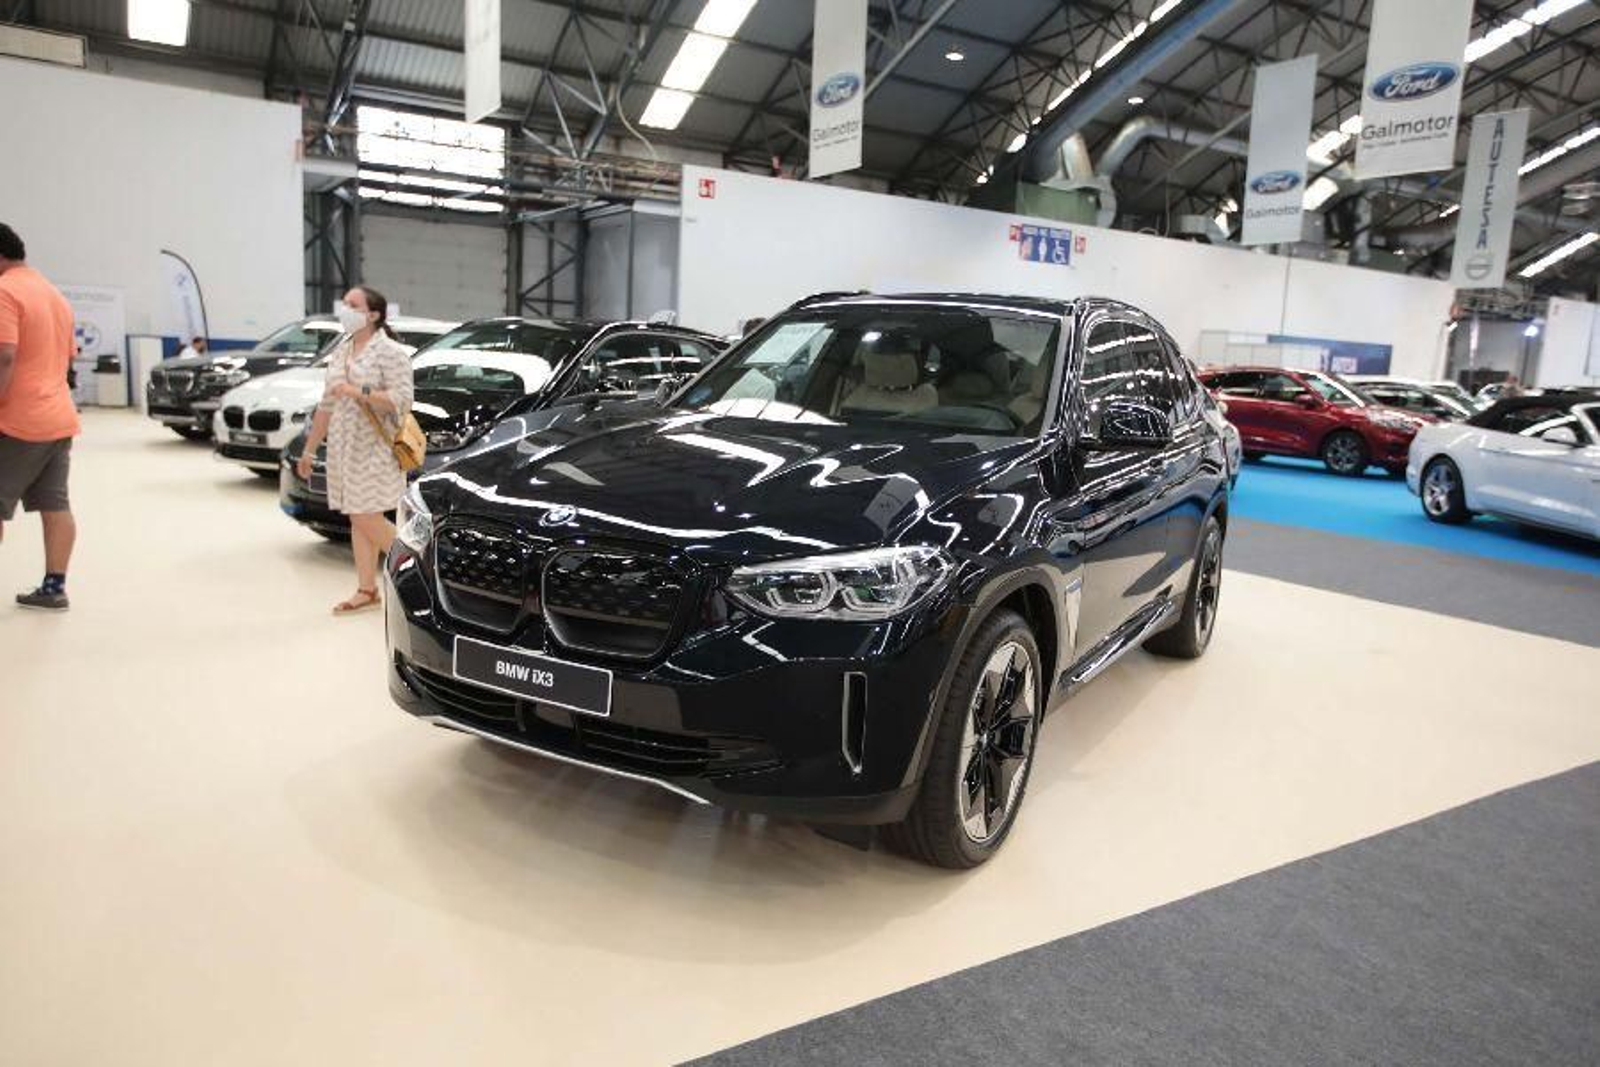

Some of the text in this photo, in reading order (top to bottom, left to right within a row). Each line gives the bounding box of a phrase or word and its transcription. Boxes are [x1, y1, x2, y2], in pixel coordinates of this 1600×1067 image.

[821, 79, 857, 104] Ford
[1384, 69, 1443, 98] Ford
[1361, 116, 1455, 140] Galmotor
[1257, 174, 1297, 193] Ford
[1476, 117, 1505, 250] AUTESA
[495, 660, 554, 688] BMW iX3
